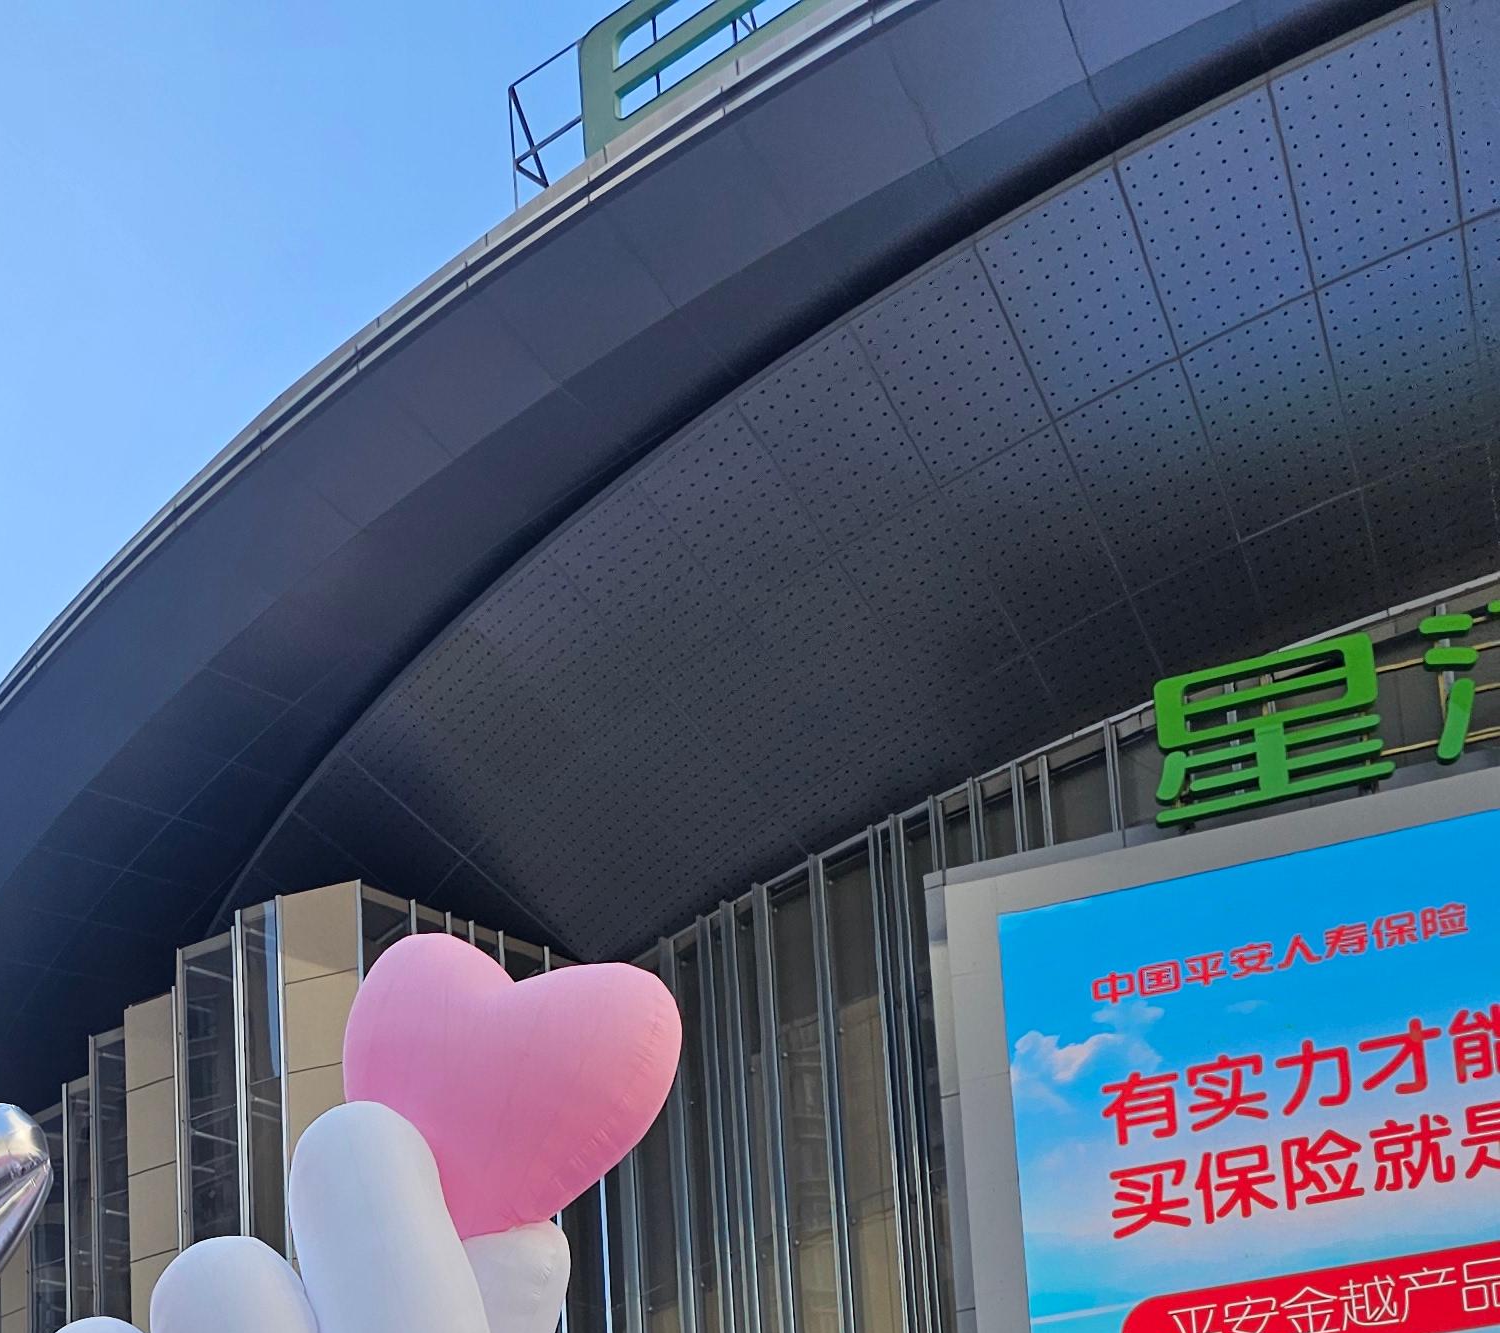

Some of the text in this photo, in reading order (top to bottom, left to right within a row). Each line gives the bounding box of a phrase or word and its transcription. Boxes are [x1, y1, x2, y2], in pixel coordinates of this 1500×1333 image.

[1091, 902, 1469, 1004] 中国平安人寿保险
